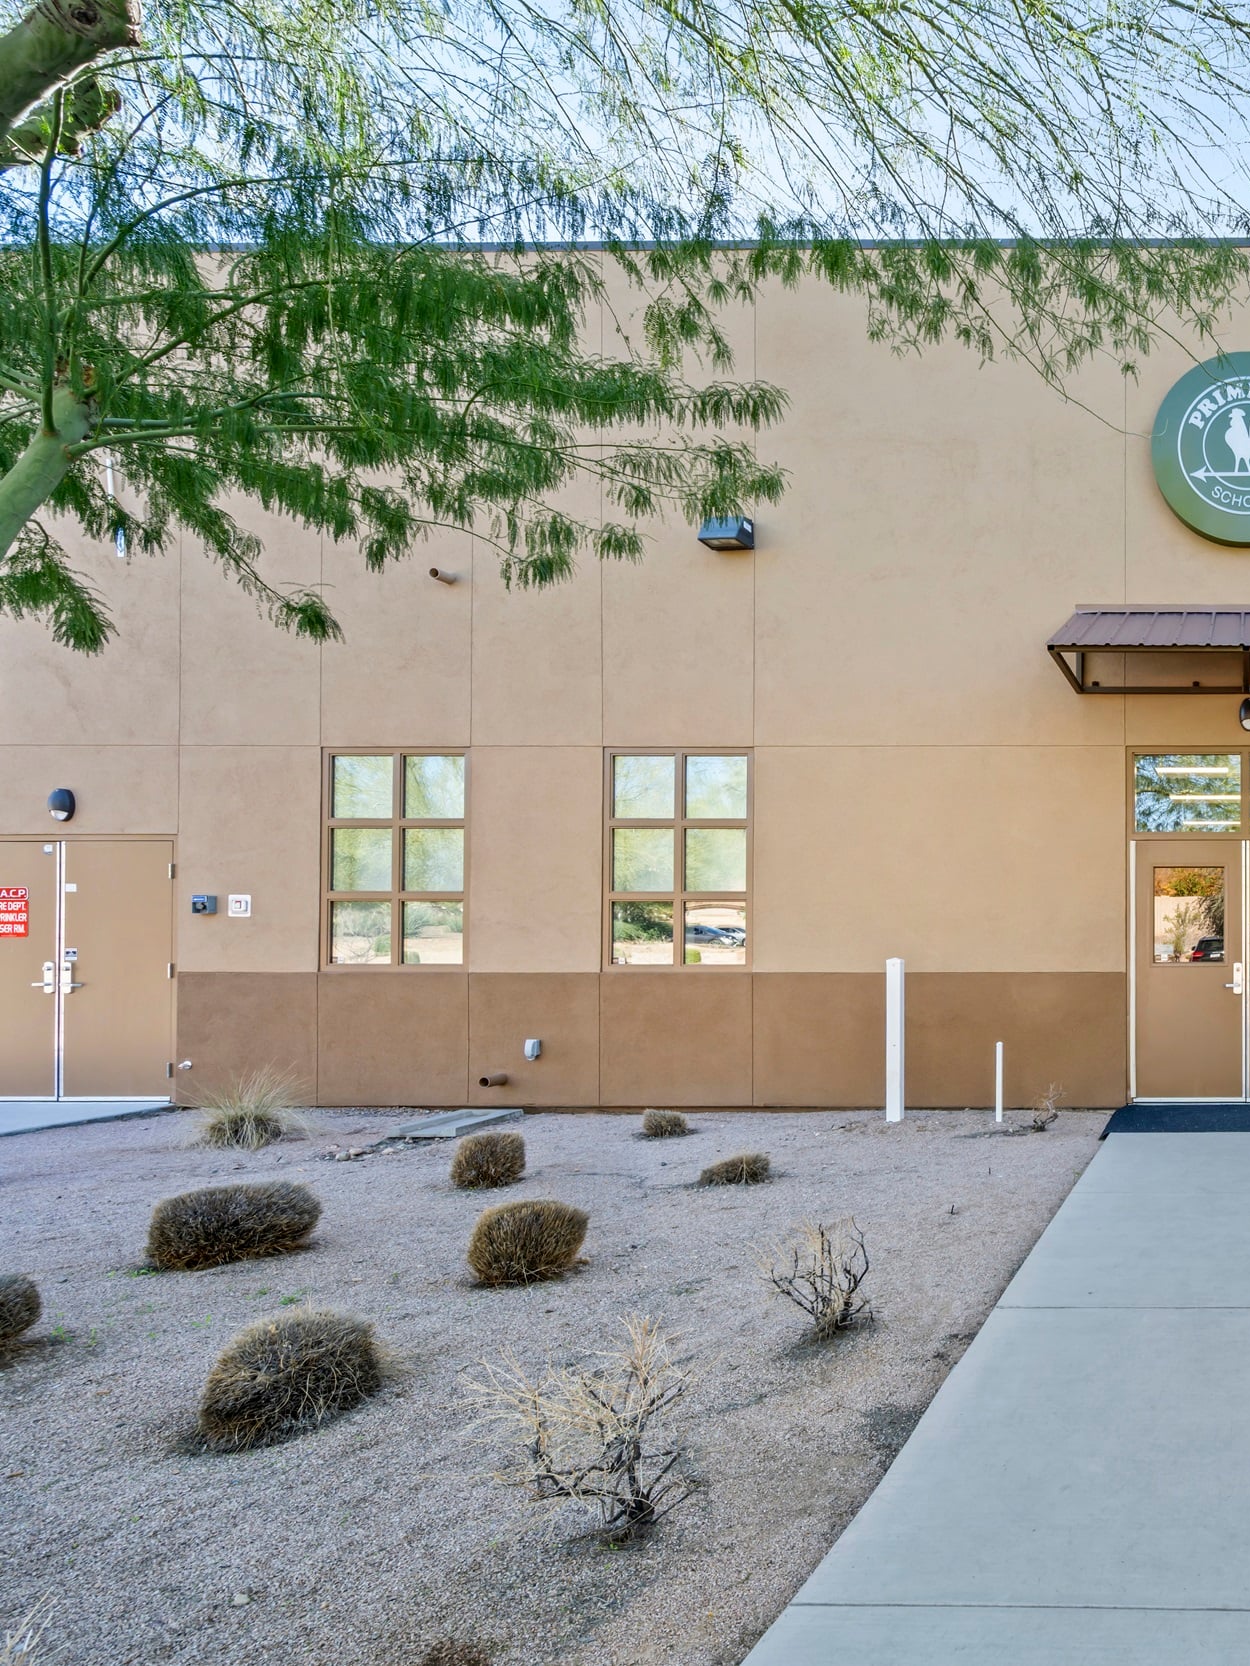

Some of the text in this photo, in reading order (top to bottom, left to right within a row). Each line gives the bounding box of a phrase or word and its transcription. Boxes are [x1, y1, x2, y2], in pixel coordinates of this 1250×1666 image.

[8, 902, 26, 911] DEPT.
[0, 913, 27, 922] RINKLER
[14, 924, 25, 933] RM.
